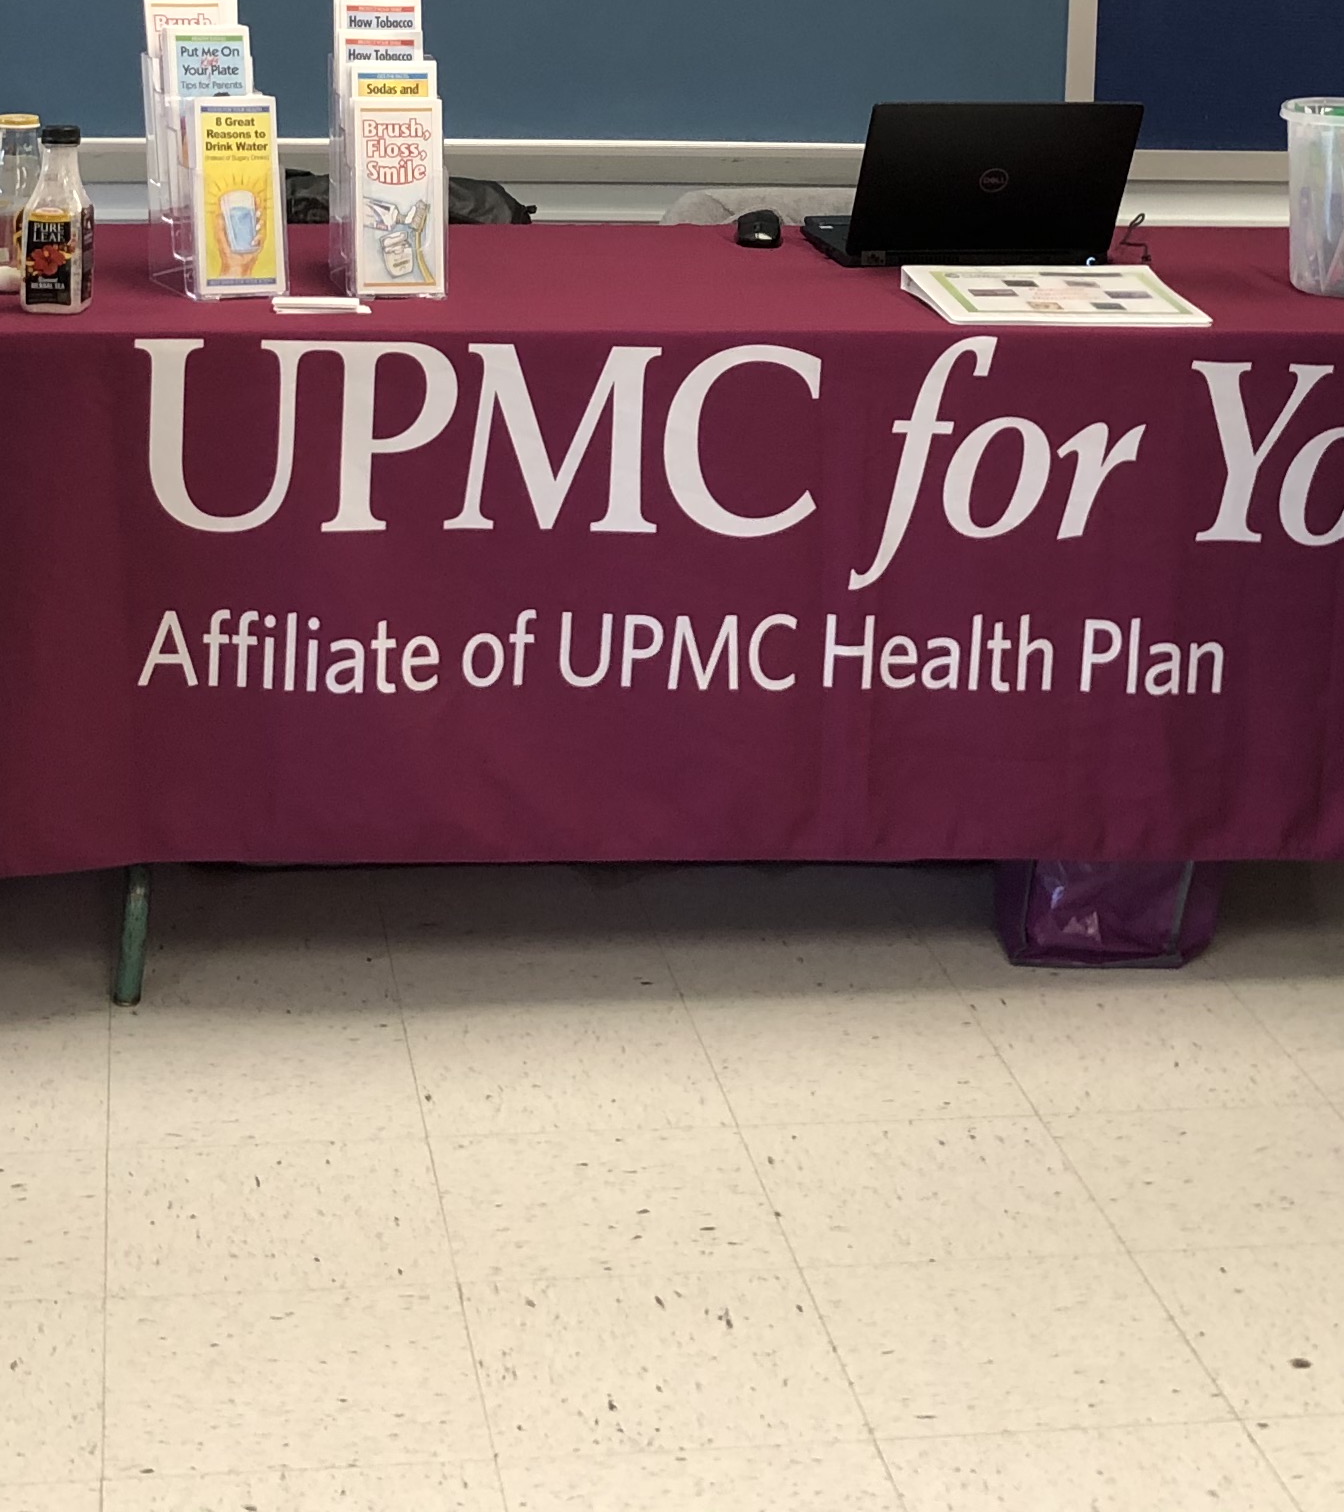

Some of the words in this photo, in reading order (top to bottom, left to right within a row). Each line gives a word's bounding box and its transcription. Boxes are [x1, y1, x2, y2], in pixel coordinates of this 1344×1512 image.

[349, 15, 372, 28] How
[375, 15, 414, 29] Tobacco
[180, 46, 199, 58] Put
[201, 46, 219, 58] Me
[220, 45, 240, 58] On
[348, 48, 372, 61] How
[374, 48, 413, 61] Tobacco
[182, 64, 209, 76] Your
[211, 64, 240, 76] Plate
[181, 80, 196, 90] Tips
[198, 80, 210, 89] for
[212, 80, 243, 89] Parents
[366, 83, 397, 95] Sodas
[400, 83, 420, 95] and
[216, 116, 223, 127] 8
[224, 116, 256, 127] Great
[206, 129, 252, 139] Reasons
[254, 129, 267, 139] to
[362, 117, 432, 141] Brush,
[205, 141, 233, 151] Drink
[235, 141, 269, 151] Water
[365, 137, 428, 161] Floss,
[366, 158, 427, 186] Smile
[33, 222, 65, 232] PURE
[32, 232, 65, 243] LEAF
[134, 336, 824, 539] UPMC
[846, 334, 1148, 592] for
[136, 609, 441, 694] Affiliate
[461, 609, 538, 689] of
[558, 611, 799, 693] UPMC
[821, 613, 1055, 693] Health
[1079, 617, 1225, 696] Plan
